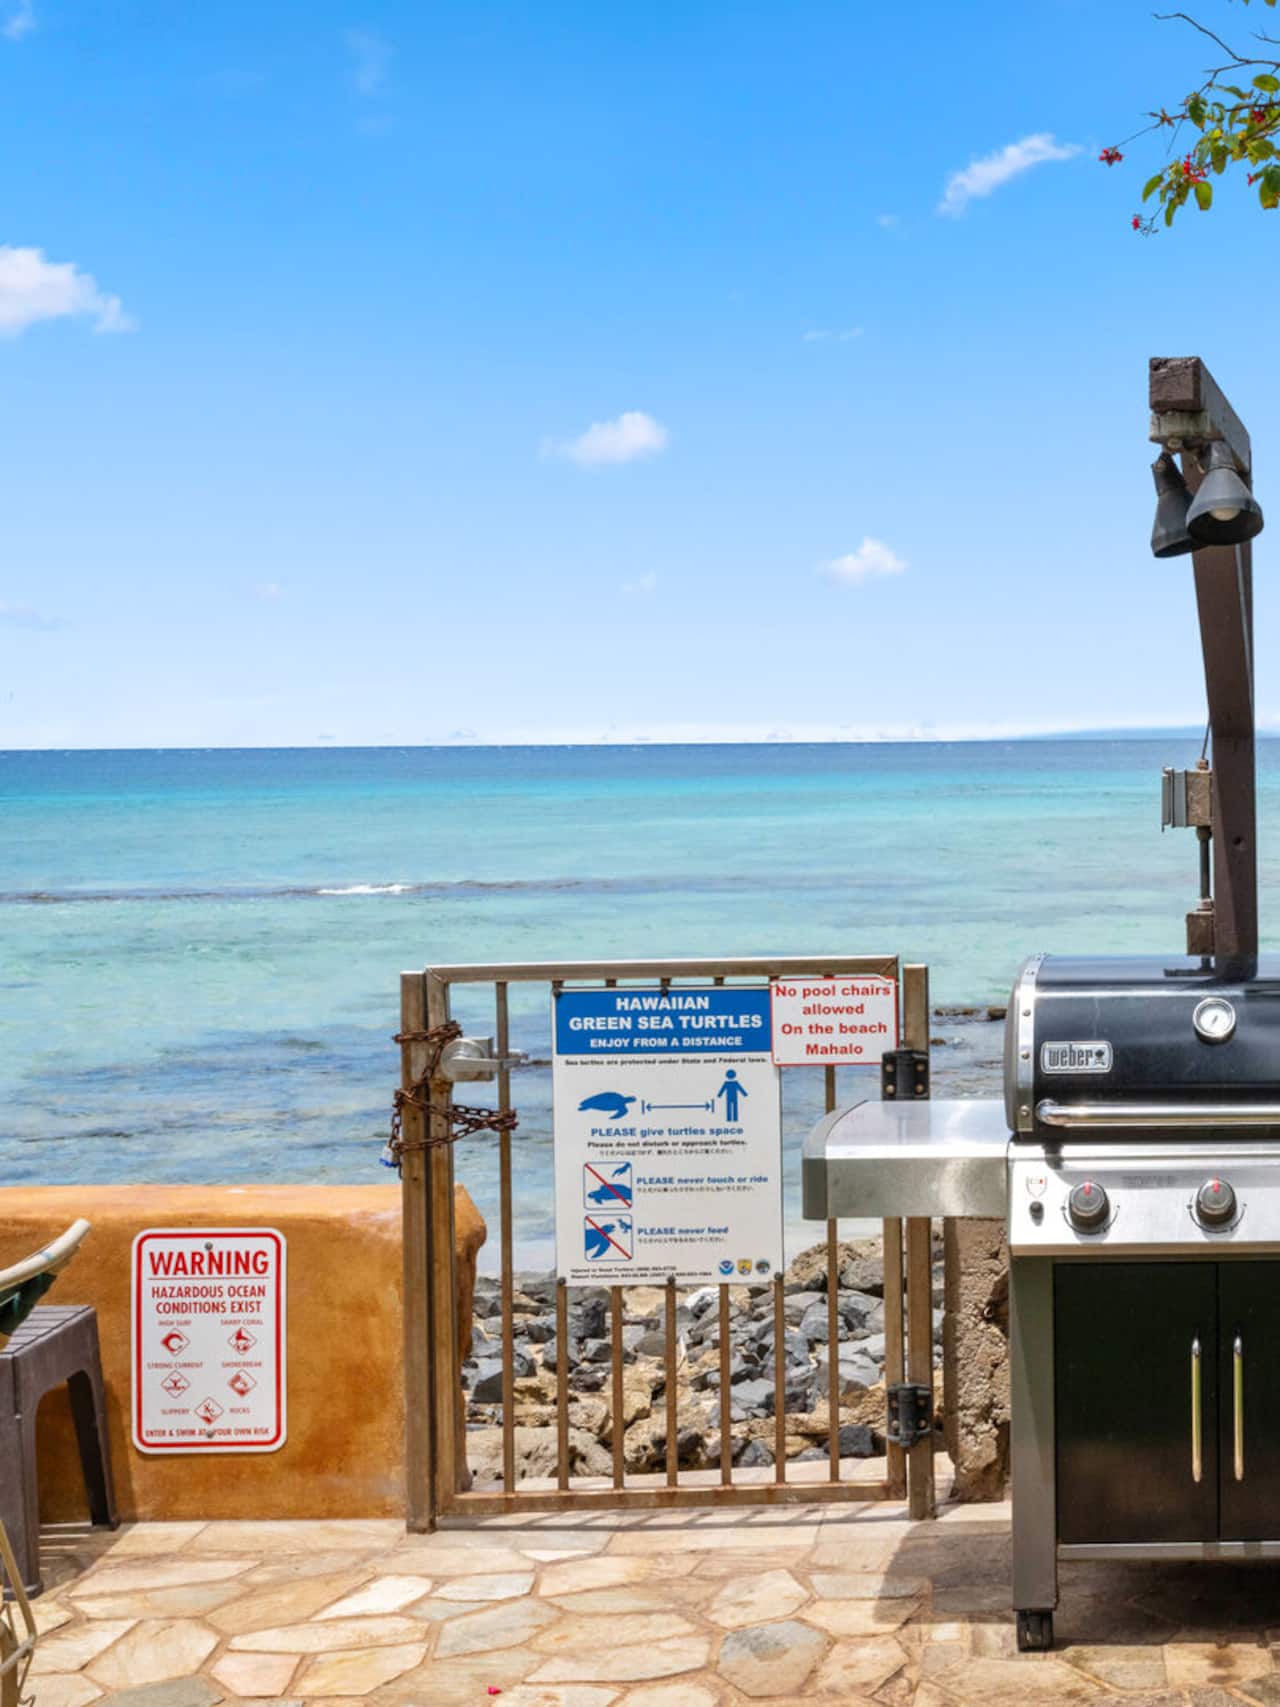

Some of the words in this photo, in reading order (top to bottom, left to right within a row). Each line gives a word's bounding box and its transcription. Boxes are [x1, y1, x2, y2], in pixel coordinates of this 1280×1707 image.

[775, 985, 797, 997] No
[802, 984, 836, 999] pool
[841, 983, 891, 996] chairs
[615, 996, 710, 1011] HAWAIIAN
[802, 1003, 865, 1015] allowed
[569, 1015, 632, 1031] GREEN
[637, 1015, 674, 1030] SEA
[679, 1014, 763, 1029] TURTLES
[781, 1023, 803, 1034] On
[808, 1023, 834, 1034] the
[839, 1022, 887, 1034] beach
[590, 1038, 629, 1048] ENJOY
[633, 1037, 667, 1047] FROM
[670, 1037, 679, 1047] A
[682, 1036, 742, 1047] DISTANCE
[805, 1043, 864, 1056] Mahalo
[1048, 1044, 1093, 1067] weber
[620, 1058, 657, 1067] protected
[591, 1128, 636, 1137] PLEASE
[640, 1128, 664, 1138] give
[667, 1127, 705, 1136] turtles
[709, 1127, 744, 1137] space
[681, 1140, 718, 1148] approach
[637, 1177, 674, 1185] PLEASE
[707, 1176, 735, 1184] touch
[637, 1227, 675, 1235] PLEASE
[149, 1250, 269, 1275] WARNING
[151, 1286, 223, 1299] HAZARDOUS
[227, 1285, 266, 1298] OCEAN
[156, 1301, 227, 1314] CONDITIONS
[230, 1300, 262, 1313] EXIST
